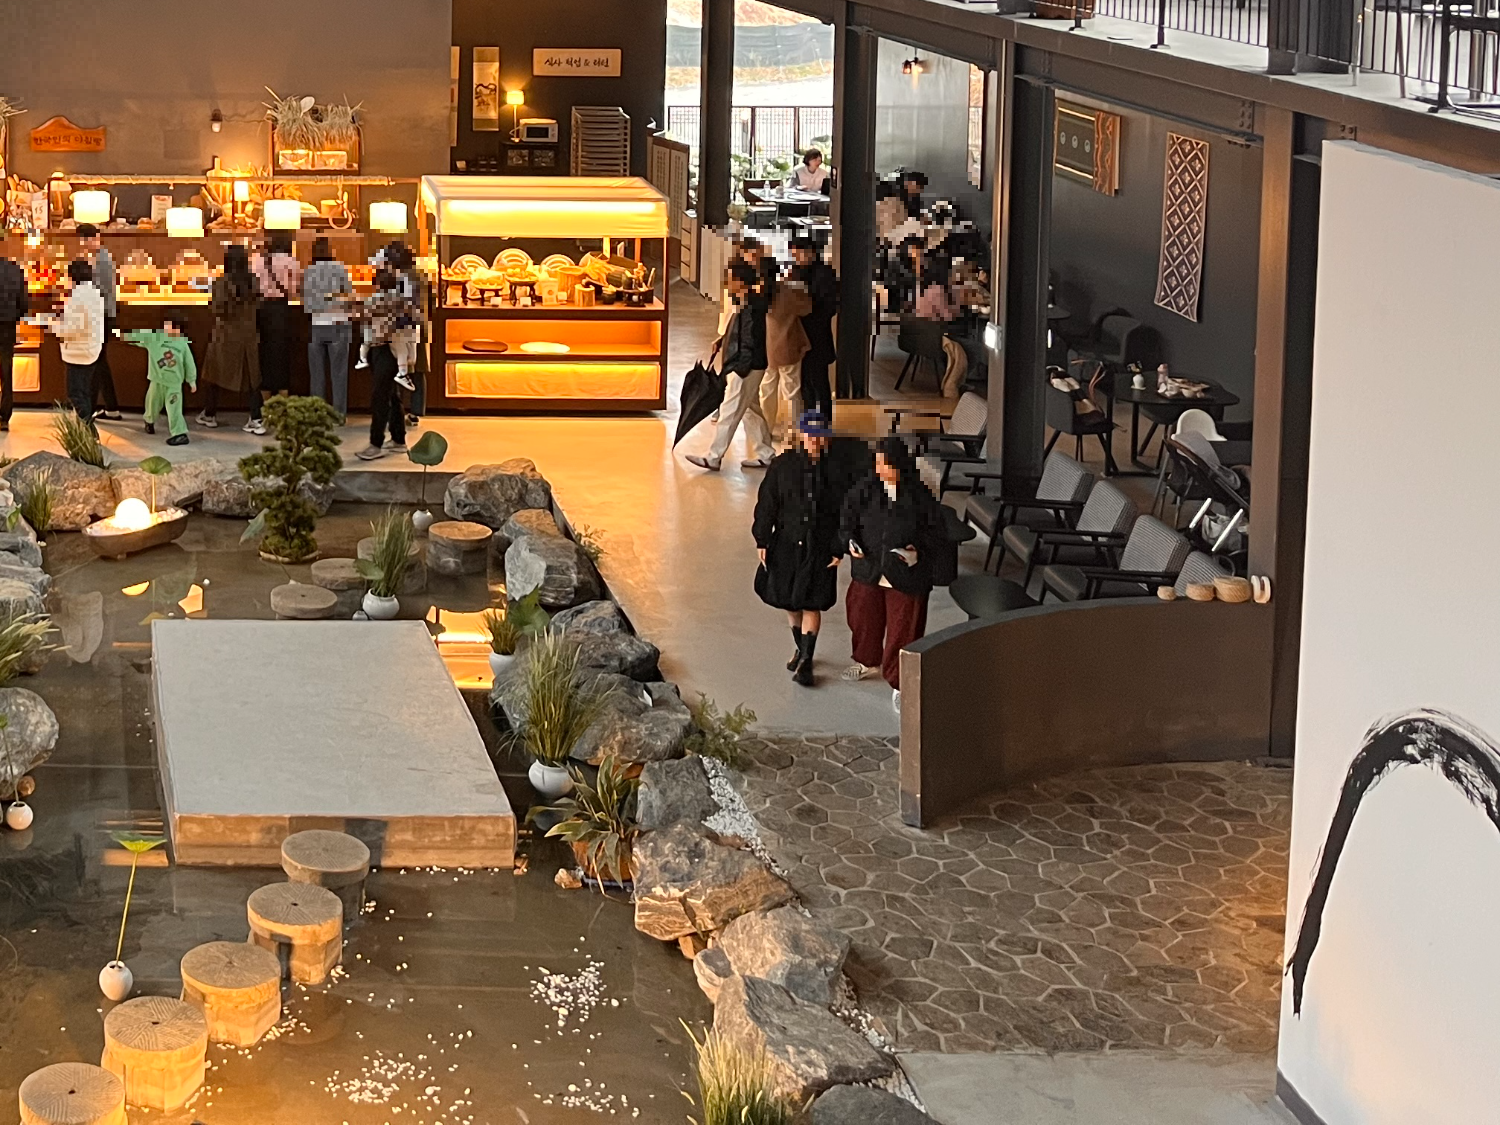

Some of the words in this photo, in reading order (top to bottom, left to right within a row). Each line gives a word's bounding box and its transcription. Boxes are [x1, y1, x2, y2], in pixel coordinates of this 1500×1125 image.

[544, 56, 563, 67] 식사
[583, 58, 591, 67] &
[592, 57, 610, 68] 리턴
[33, 135, 71, 146] 한국인의
